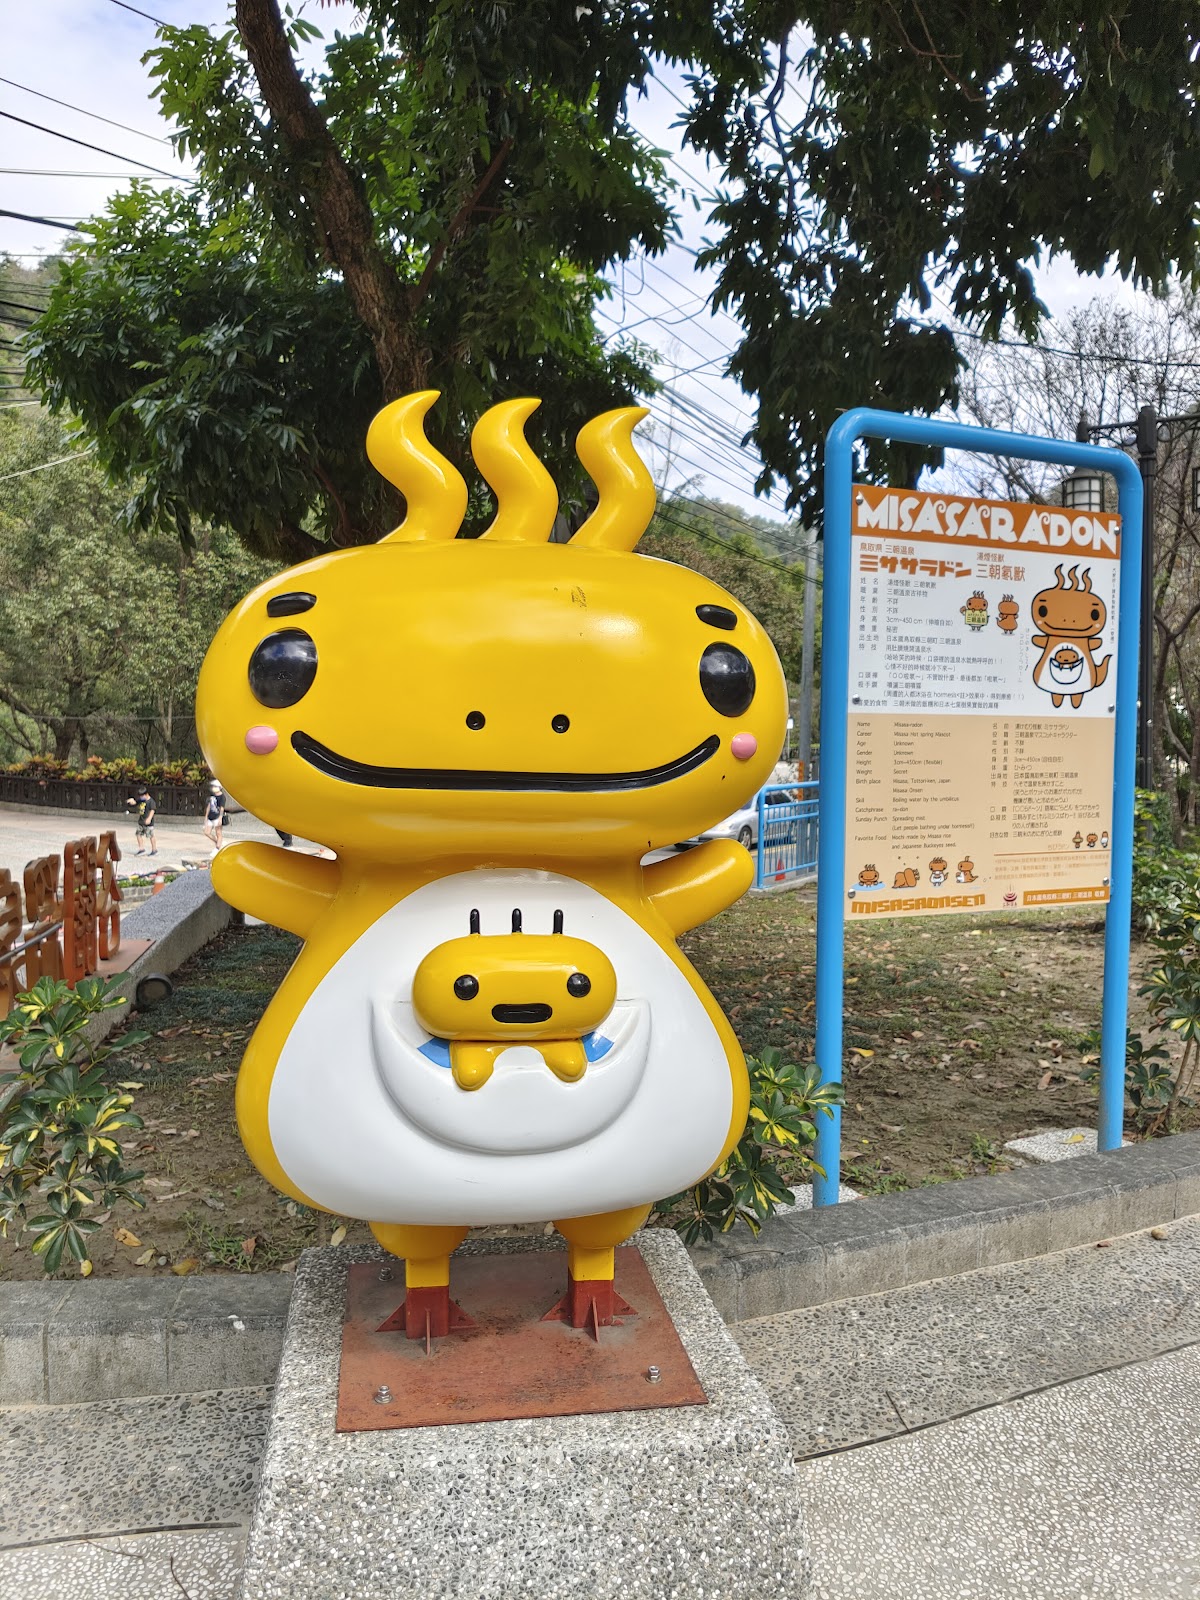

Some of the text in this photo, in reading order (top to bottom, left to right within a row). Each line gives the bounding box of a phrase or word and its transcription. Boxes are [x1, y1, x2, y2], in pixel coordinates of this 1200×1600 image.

[857, 491, 1117, 555] MISASARADON
[860, 542, 882, 553] 鳥取県
